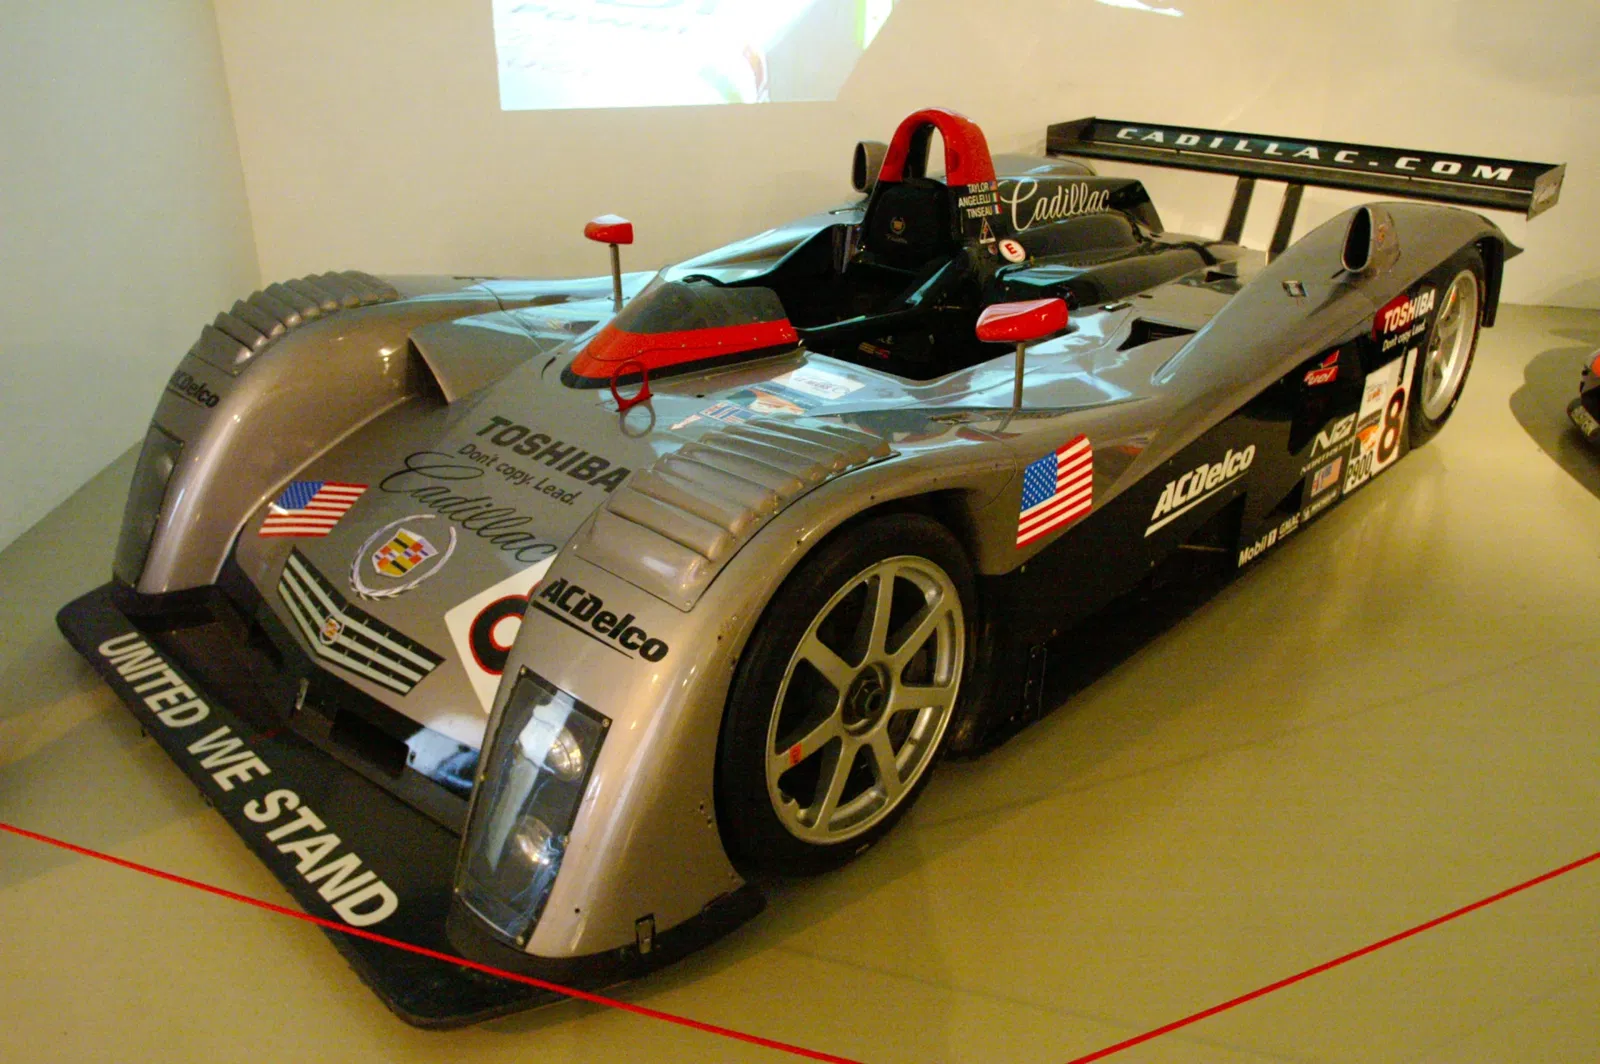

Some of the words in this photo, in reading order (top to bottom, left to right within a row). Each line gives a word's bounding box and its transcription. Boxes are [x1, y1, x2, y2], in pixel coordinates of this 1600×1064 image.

[1115, 127, 1513, 181] CADILLAC.COM
[966, 205, 992, 219] TINSEAU
[967, 182, 989, 194] TAYLOR
[998, 178, 1109, 231] Cadillac
[1004, 243, 1017, 255] E
[1383, 289, 1436, 335] TOSHIBA
[476, 415, 631, 493] TOSHIBA
[379, 451, 558, 563] Cadillac
[1151, 444, 1256, 521] ACDelco
[1238, 535, 1268, 568] Mobil
[539, 577, 669, 663] ACDelco
[98, 631, 210, 728] UNITED
[187, 725, 271, 792] WE
[243, 789, 399, 928] STAND
